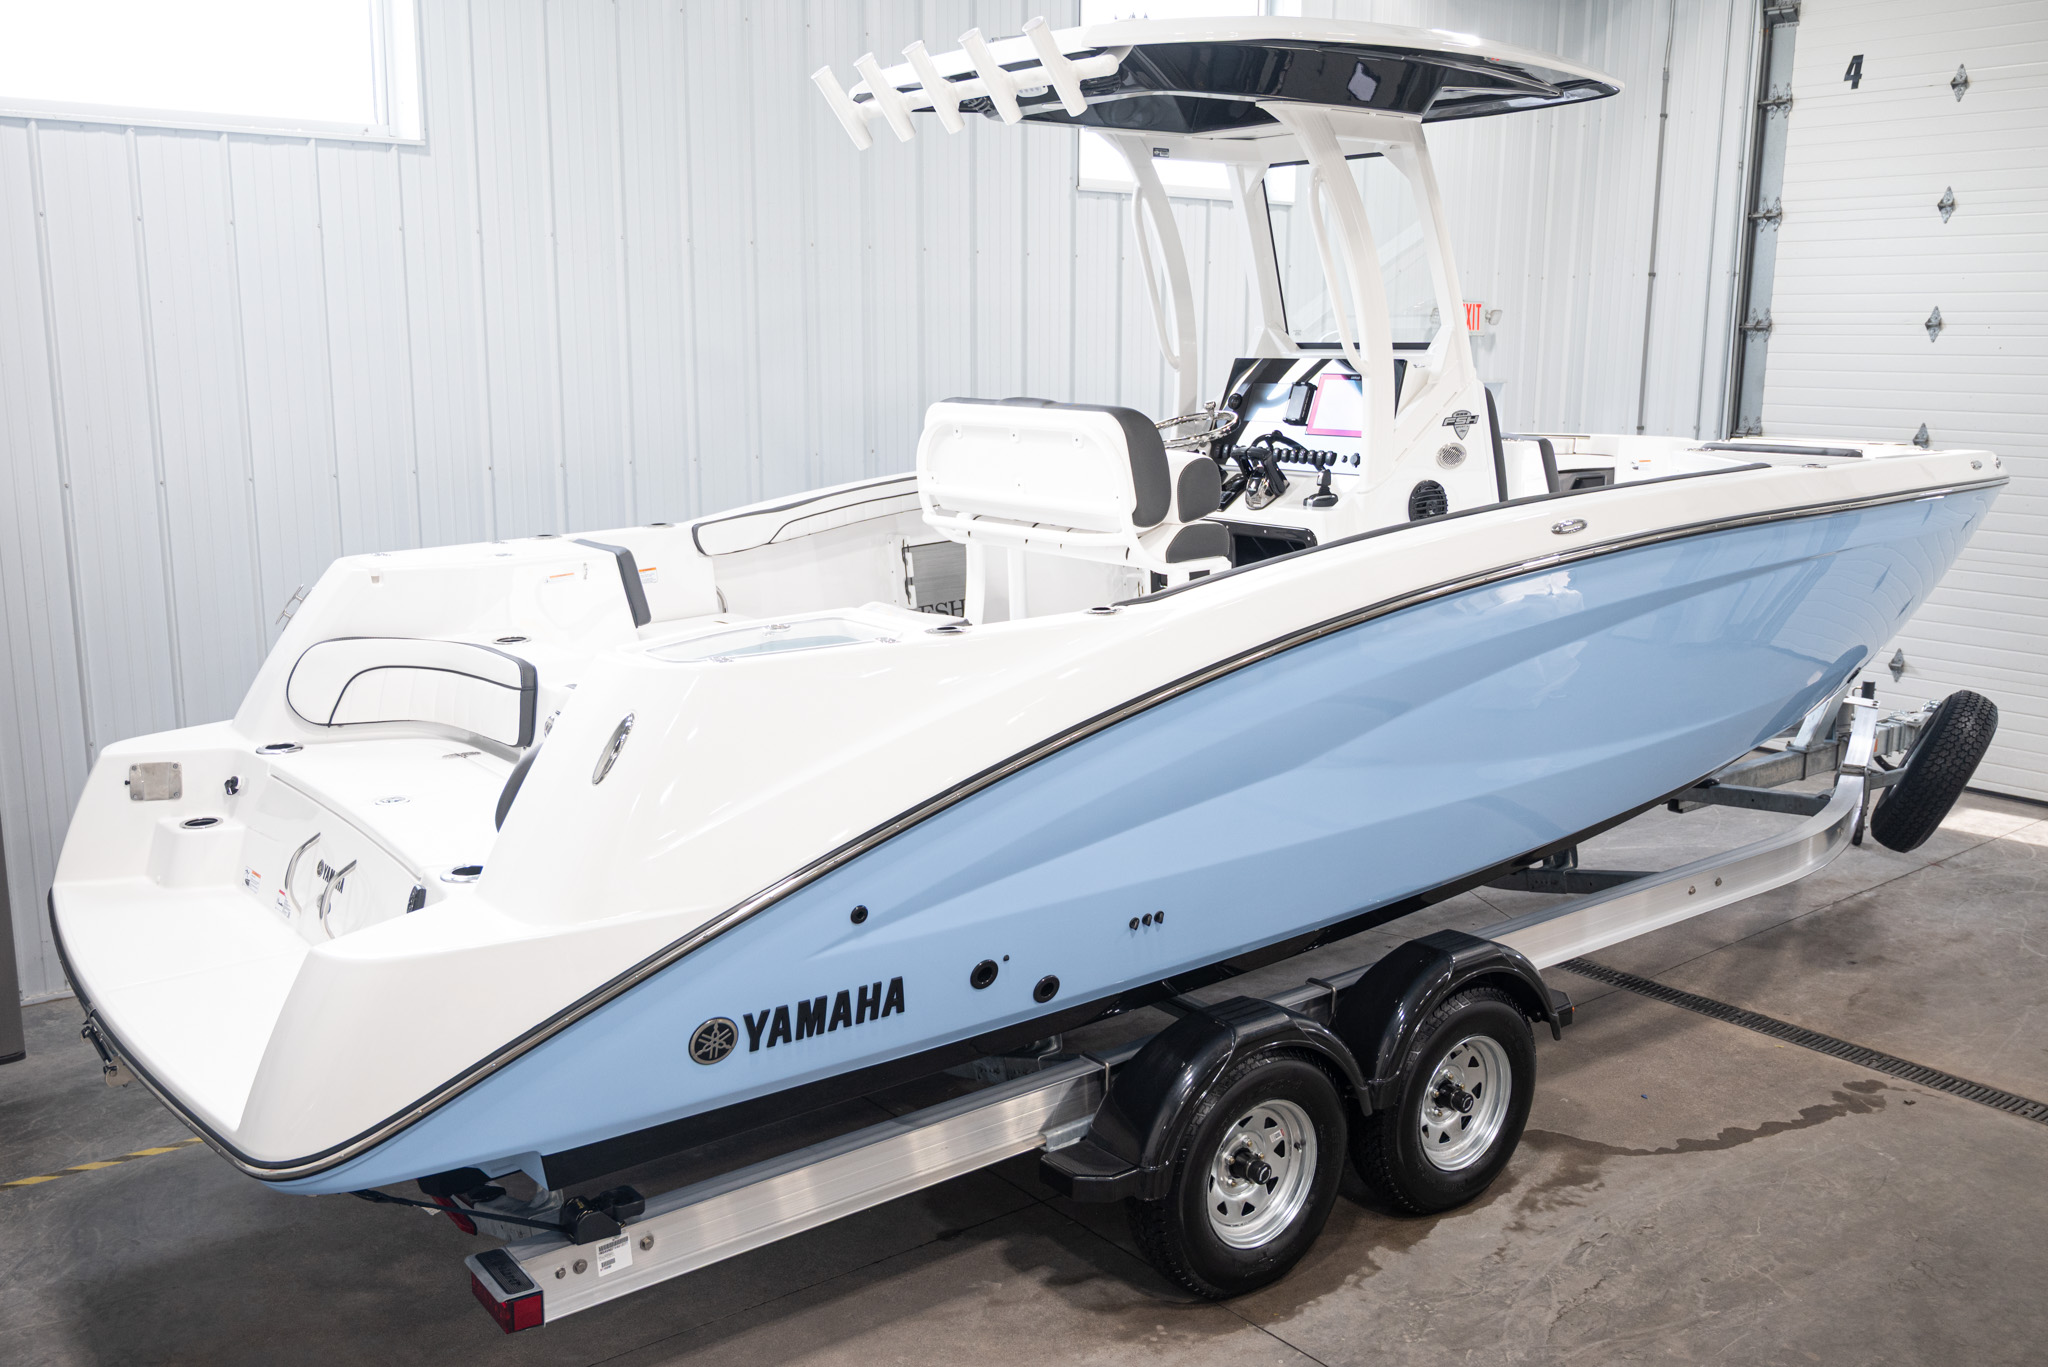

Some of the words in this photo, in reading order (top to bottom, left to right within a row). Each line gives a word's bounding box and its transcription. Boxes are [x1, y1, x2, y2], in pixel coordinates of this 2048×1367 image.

[1844, 54, 1864, 90] 4
[1463, 303, 1482, 331] XIT
[1442, 415, 1479, 426] FSH
[743, 976, 905, 1053] YAMAHA
